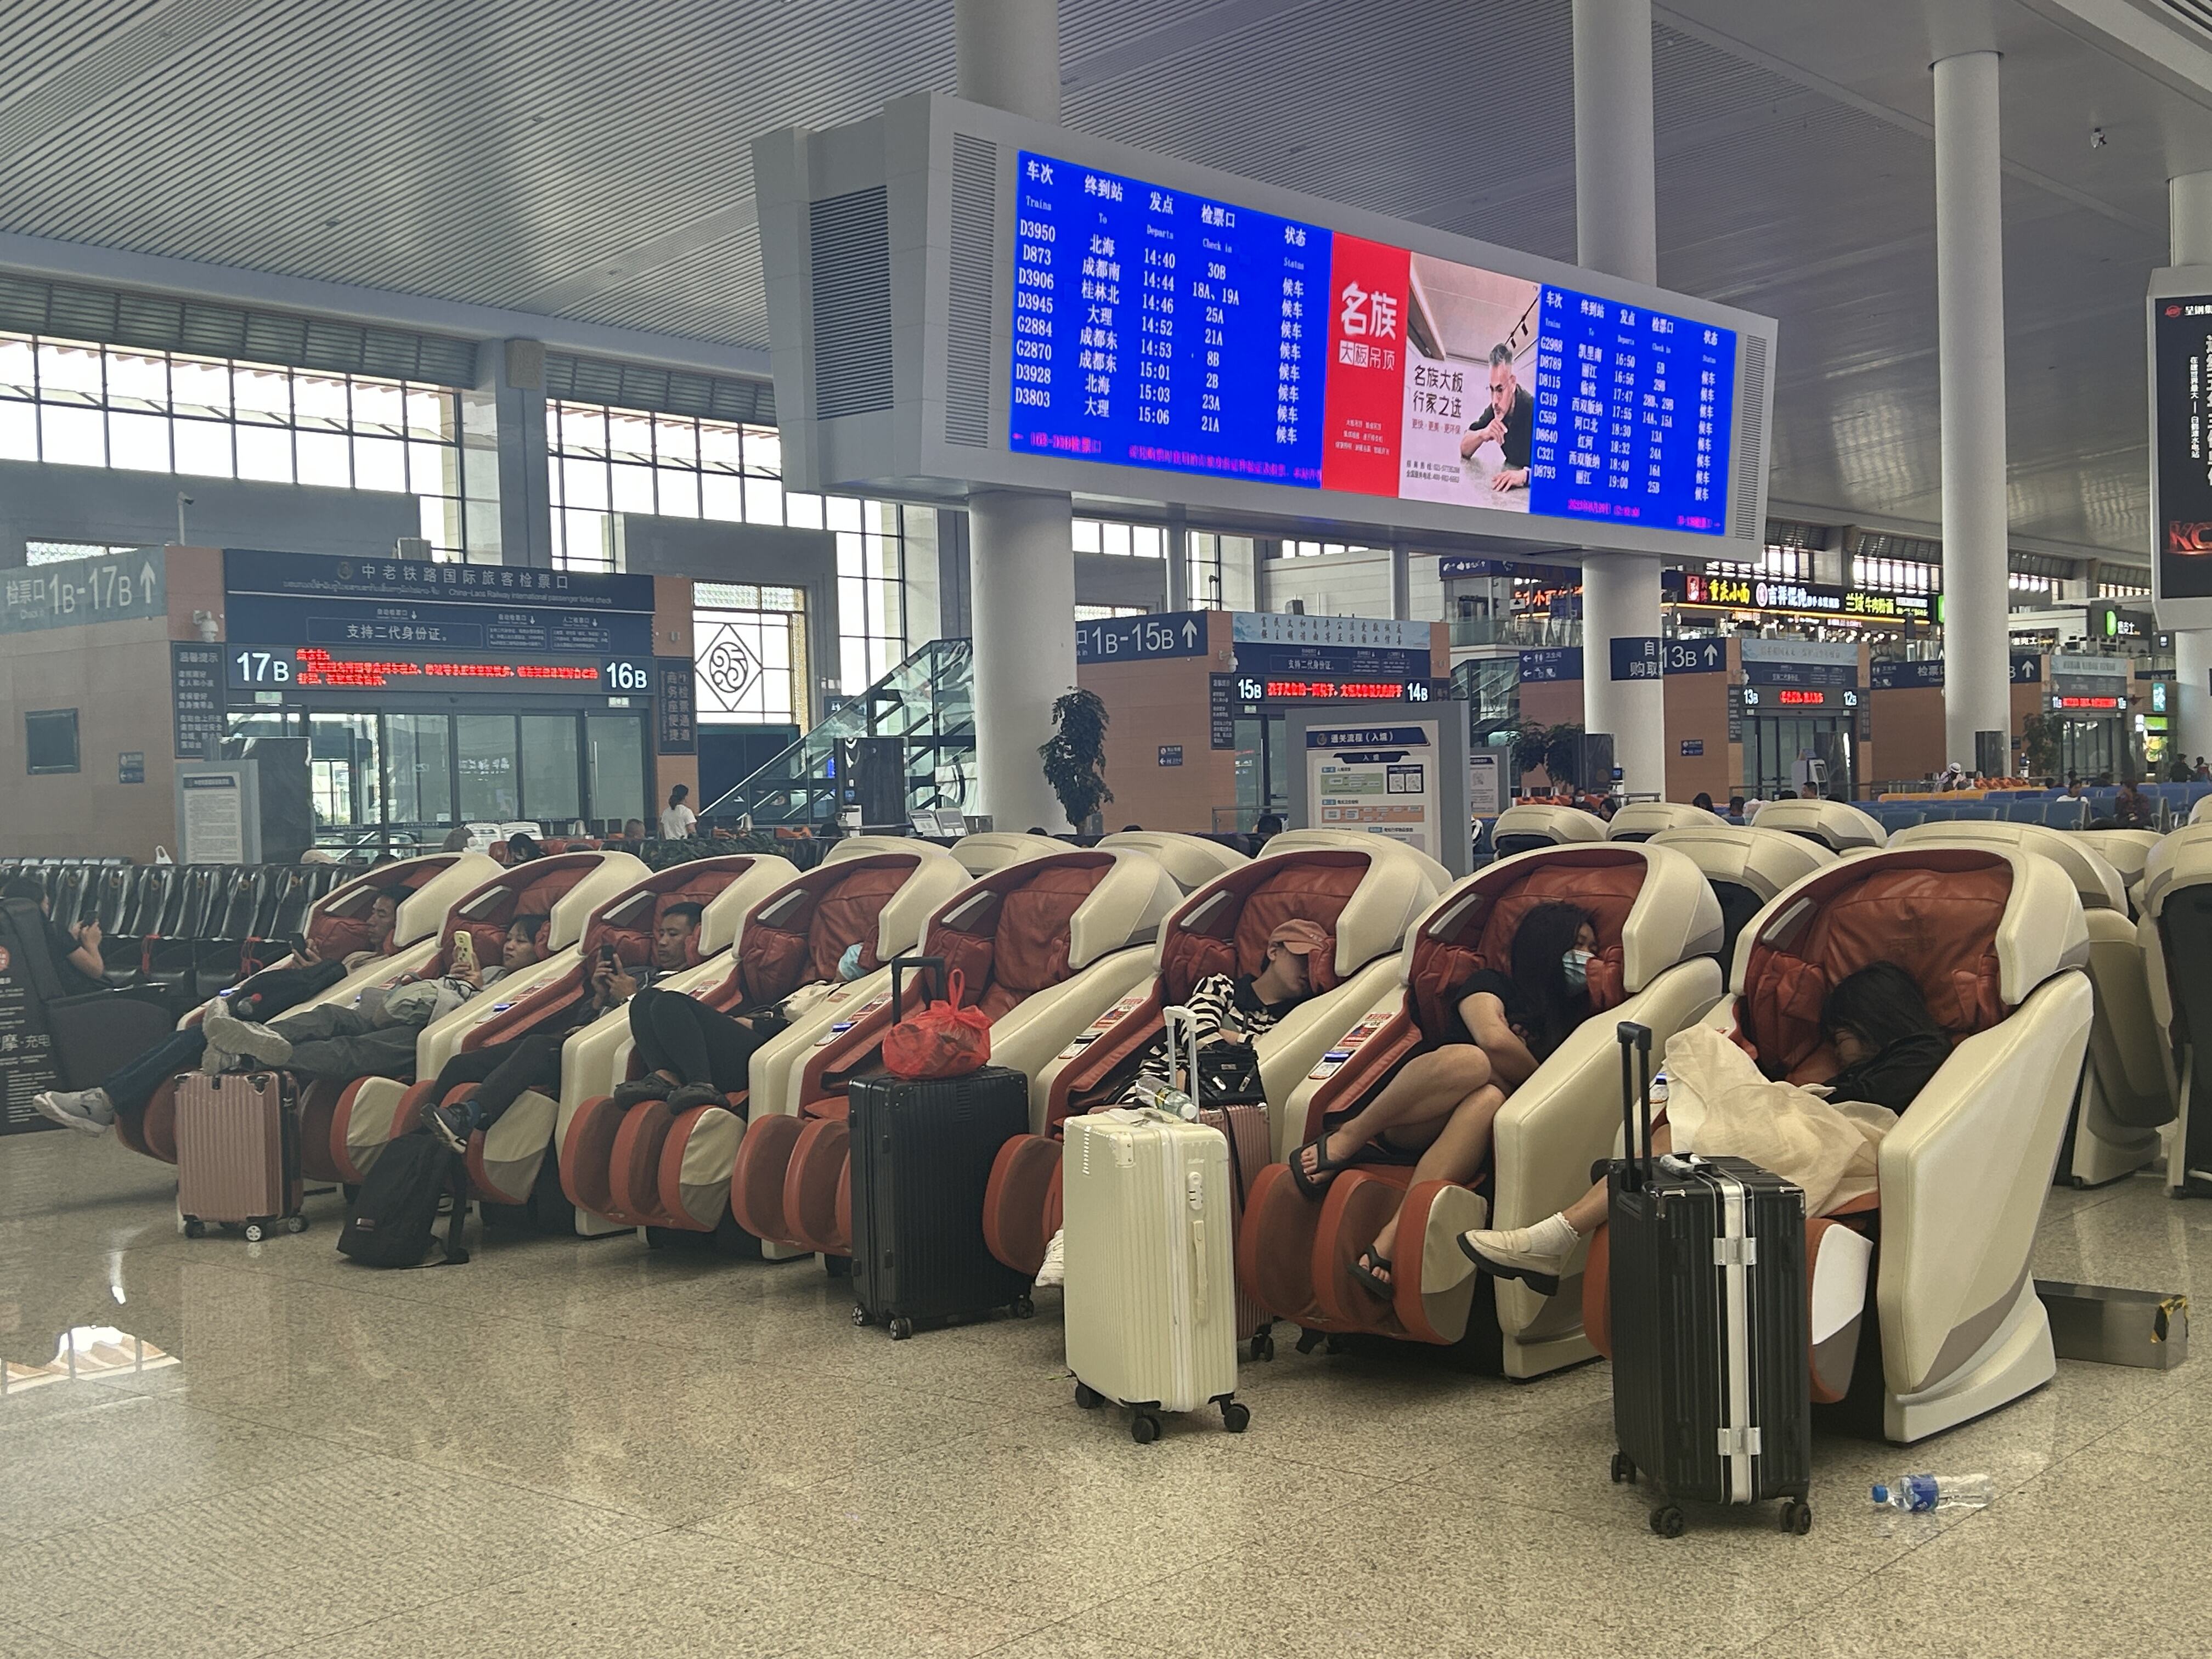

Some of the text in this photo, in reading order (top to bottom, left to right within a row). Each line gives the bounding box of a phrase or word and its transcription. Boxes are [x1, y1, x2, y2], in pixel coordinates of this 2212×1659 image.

[1027, 160, 1306, 247] 车次 终到站 发点 检票口 状态
[1020, 219, 1304, 298] D3950 北海 14:40 30B 候车
[1023, 244, 1051, 265] D873
[1082, 256, 1120, 282] 成都南
[1144, 270, 1174, 291] 14:44
[1282, 299, 1303, 319] 候车
[1019, 267, 1302, 340] D3906 桂林北 14:46 25A 候车
[1340, 281, 1397, 340] 名族
[1546, 291, 1718, 346] 车次 终到站 发点 检票口 状态
[1018, 291, 1301, 360] D3945 大理 14:52 21A 候车
[1017, 315, 1300, 382] G2884 成都东 14:53 8B 候车
[1339, 340, 1395, 370] 大板吊顶
[1016, 339, 1299, 403] G2870 成都东 15:01 2B 候车
[1414, 364, 1463, 393] 名族大板
[1539, 354, 1562, 370] D8789
[1701, 387, 1714, 402] 候车
[1616, 353, 1635, 368] 16:50
[1656, 362, 1665, 374] 5B
[1701, 371, 1716, 385] 候车
[1016, 363, 1298, 424] D3928 北海 15:03 23A 候车
[1412, 390, 1462, 419] 行家之选
[1539, 373, 1561, 389] D8115
[1613, 388, 1633, 402] 17:47
[1700, 404, 1713, 419] 候车
[1015, 387, 1297, 444] D3803 大理 15:06 21A 候车
[1539, 410, 1711, 452] C559 河口北 18:30 13A 候车
[1540, 392, 1558, 407] C319
[1572, 397, 1603, 416] 西双版纳
[1699, 421, 1712, 435] 候车
[1537, 446, 1709, 485] C321 西双版纳 18:40 16A 候车
[1578, 434, 1594, 450] 红河
[1650, 447, 1661, 460] 24A
[1696, 453, 1711, 469] 候车
[1609, 475, 1628, 489] 19:00
[1695, 487, 1709, 501] 候车
[6, 579, 44, 606] 检票口
[362, 563, 568, 590] 中老铁路国际旅客检票口
[1709, 579, 1750, 604] 重庆小面
[1768, 584, 1807, 607] 吉祥馄饨
[1092, 622, 1174, 654] 1B-15B
[236, 652, 290, 681] 17B
[606, 662, 647, 690] 16B
[1238, 679, 1262, 699] 15B
[1407, 682, 1428, 702] 14B
[1743, 689, 1759, 704] 13B
[1844, 691, 1858, 706] 12B
